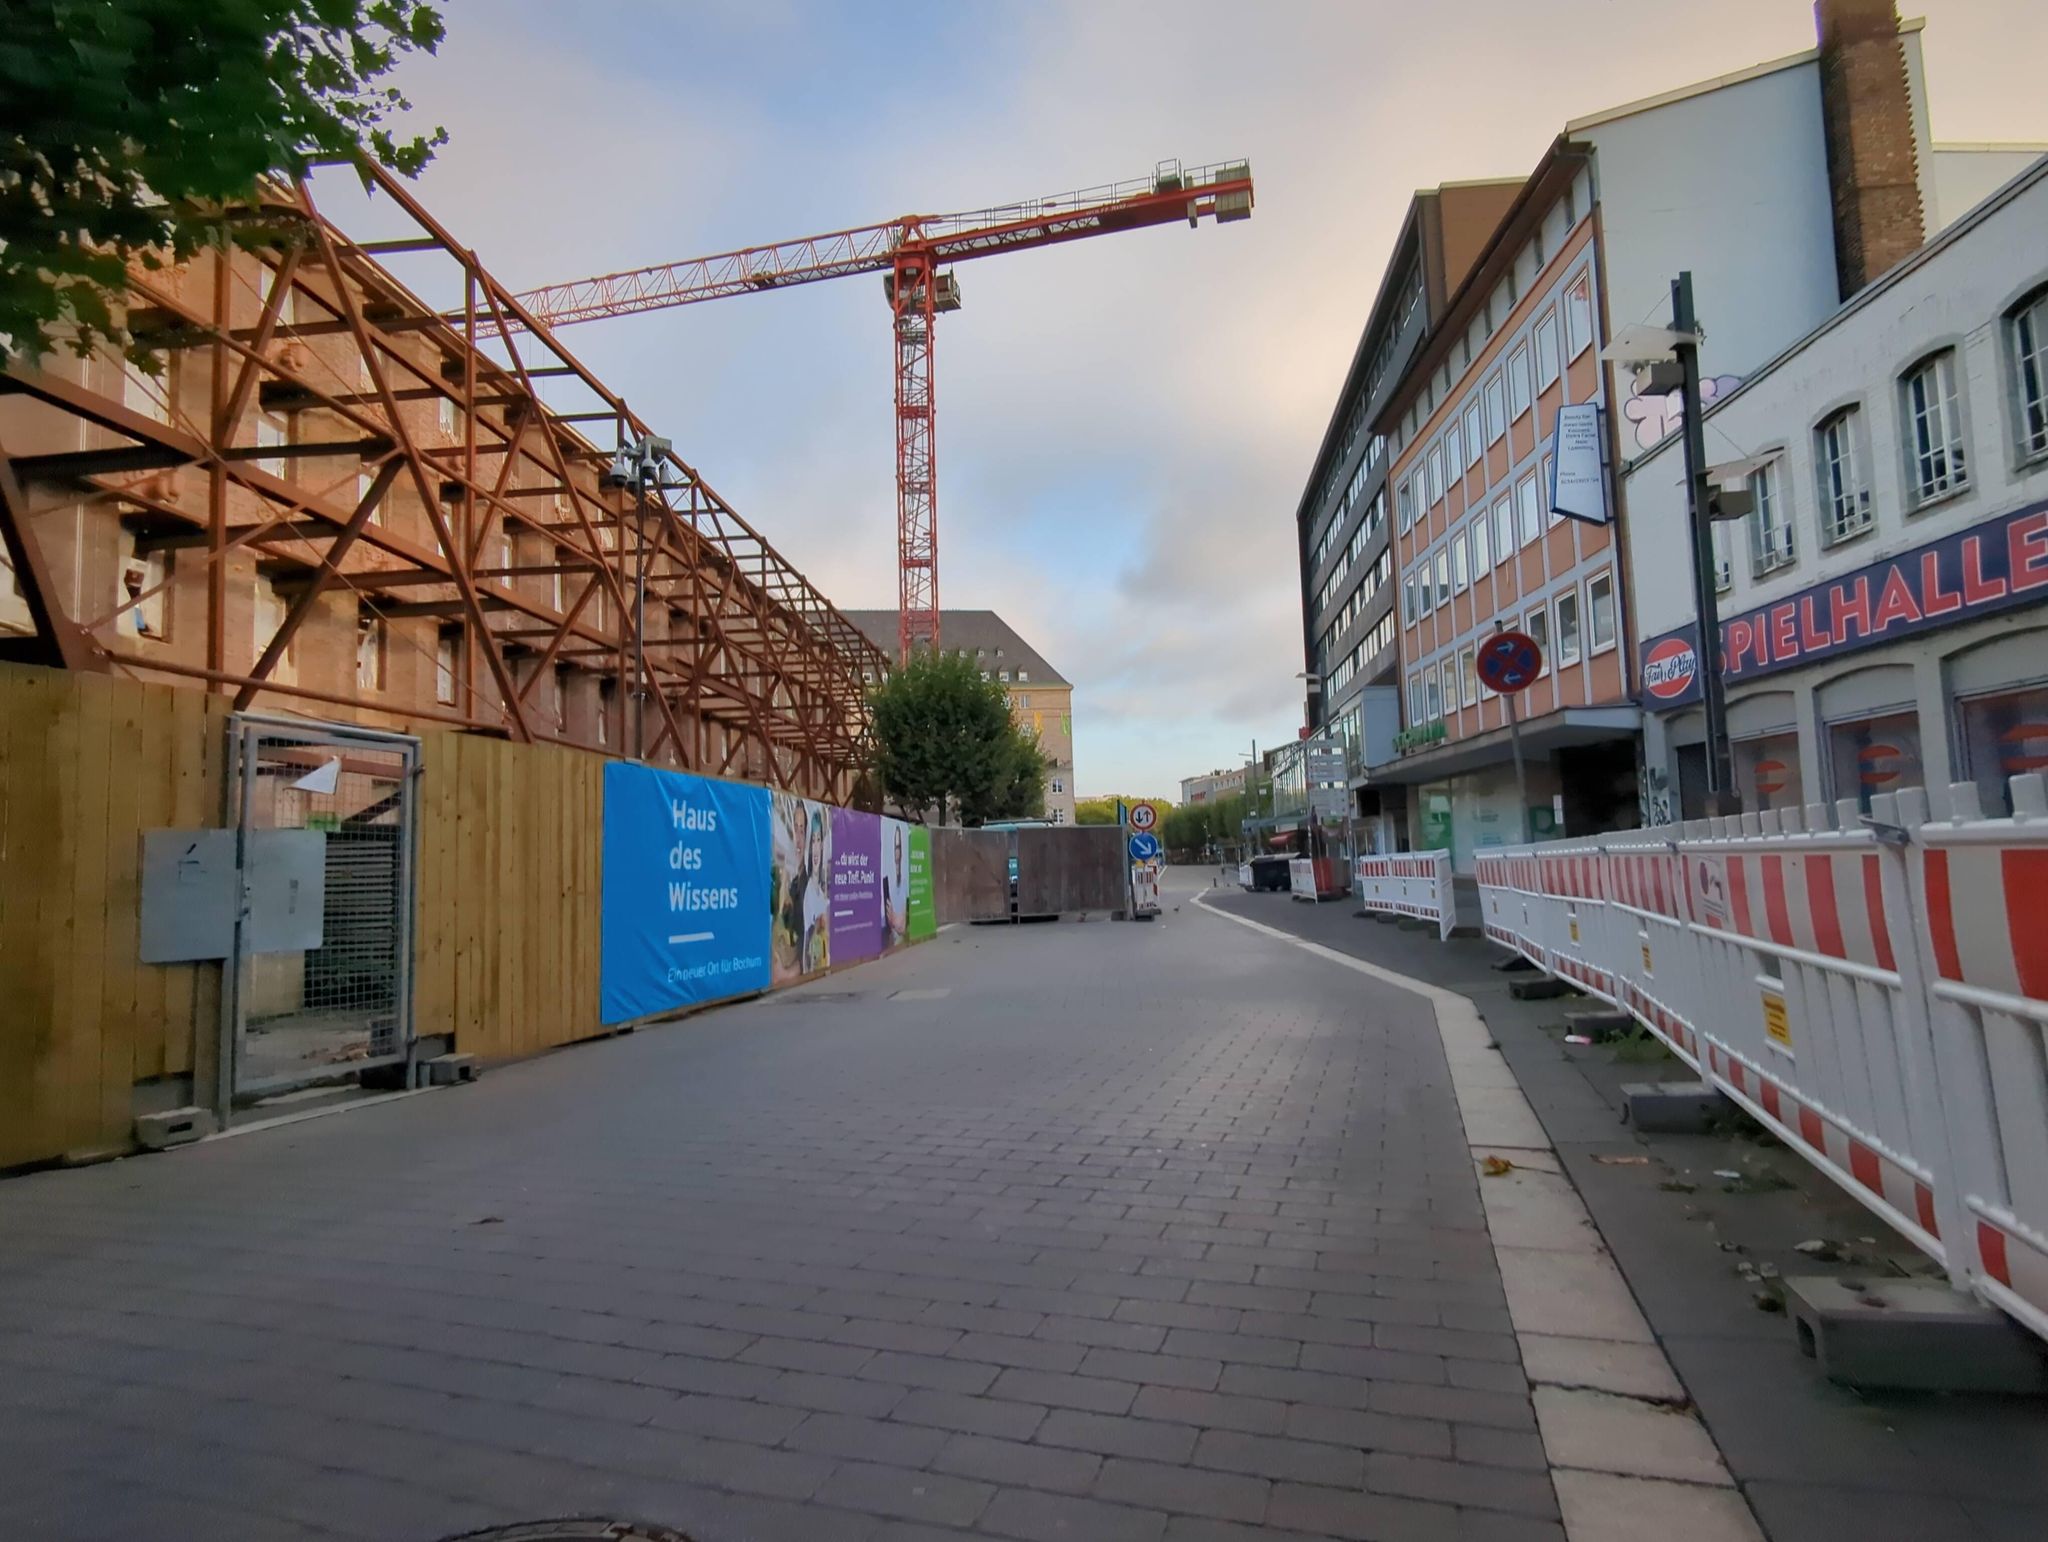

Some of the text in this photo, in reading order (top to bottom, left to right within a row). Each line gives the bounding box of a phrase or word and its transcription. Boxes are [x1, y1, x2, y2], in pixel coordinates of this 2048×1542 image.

[1719, 510, 2048, 676] PIELHALLE
[672, 799, 717, 832] Haus
[669, 841, 702, 870] des
[848, 852, 860, 866] wirst
[860, 853, 868, 866] der
[834, 873, 847, 885] neue
[668, 882, 738, 913] Wissens
[667, 957, 762, 983] Ein neuer Ort für Bochum
